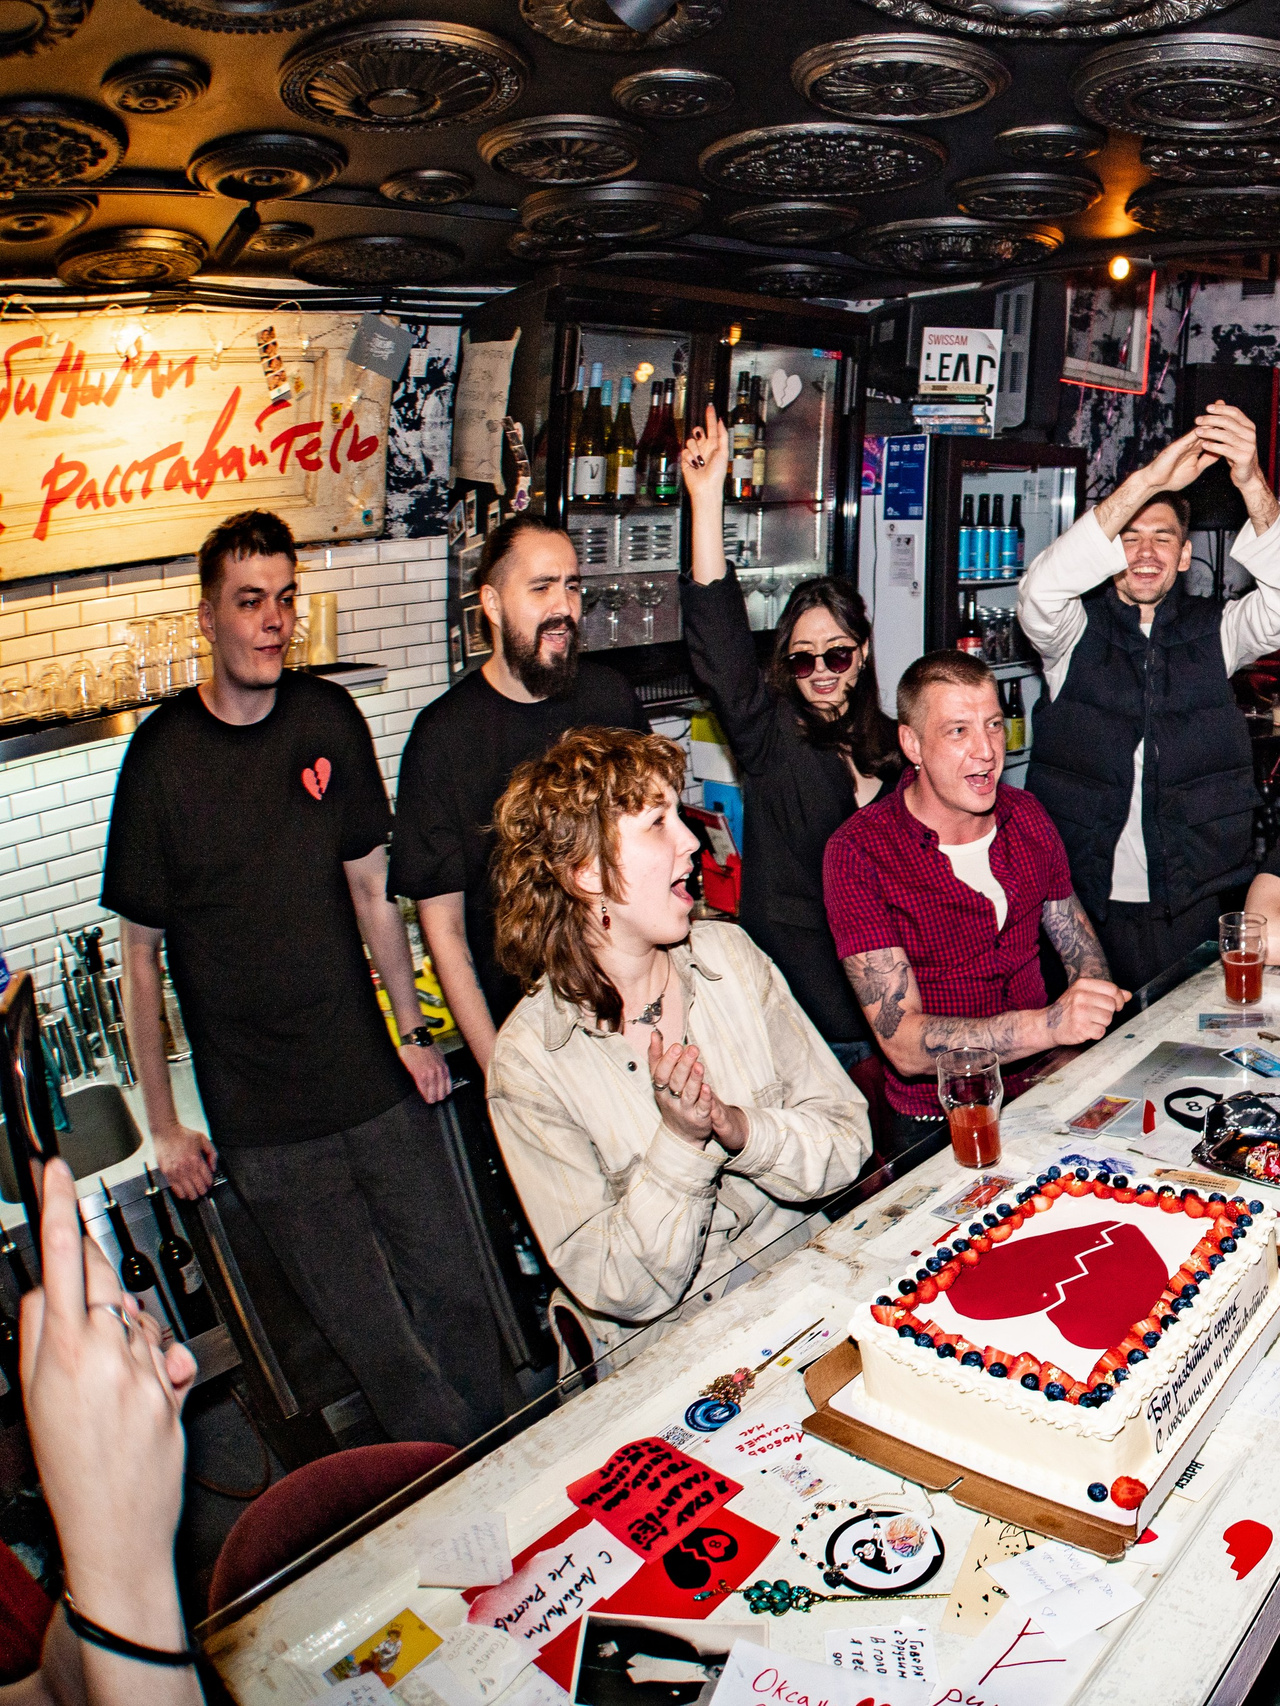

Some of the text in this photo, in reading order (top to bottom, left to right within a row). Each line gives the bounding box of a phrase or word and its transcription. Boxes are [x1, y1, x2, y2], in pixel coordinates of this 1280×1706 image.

[1147, 1289, 1242, 1424] Бар разбитых сердец
[1155, 1428, 1163, 1454] С
[1166, 1373, 1214, 1441] любимыми
[1213, 1355, 1224, 1372] не
[873, 1648, 887, 1675] голо
